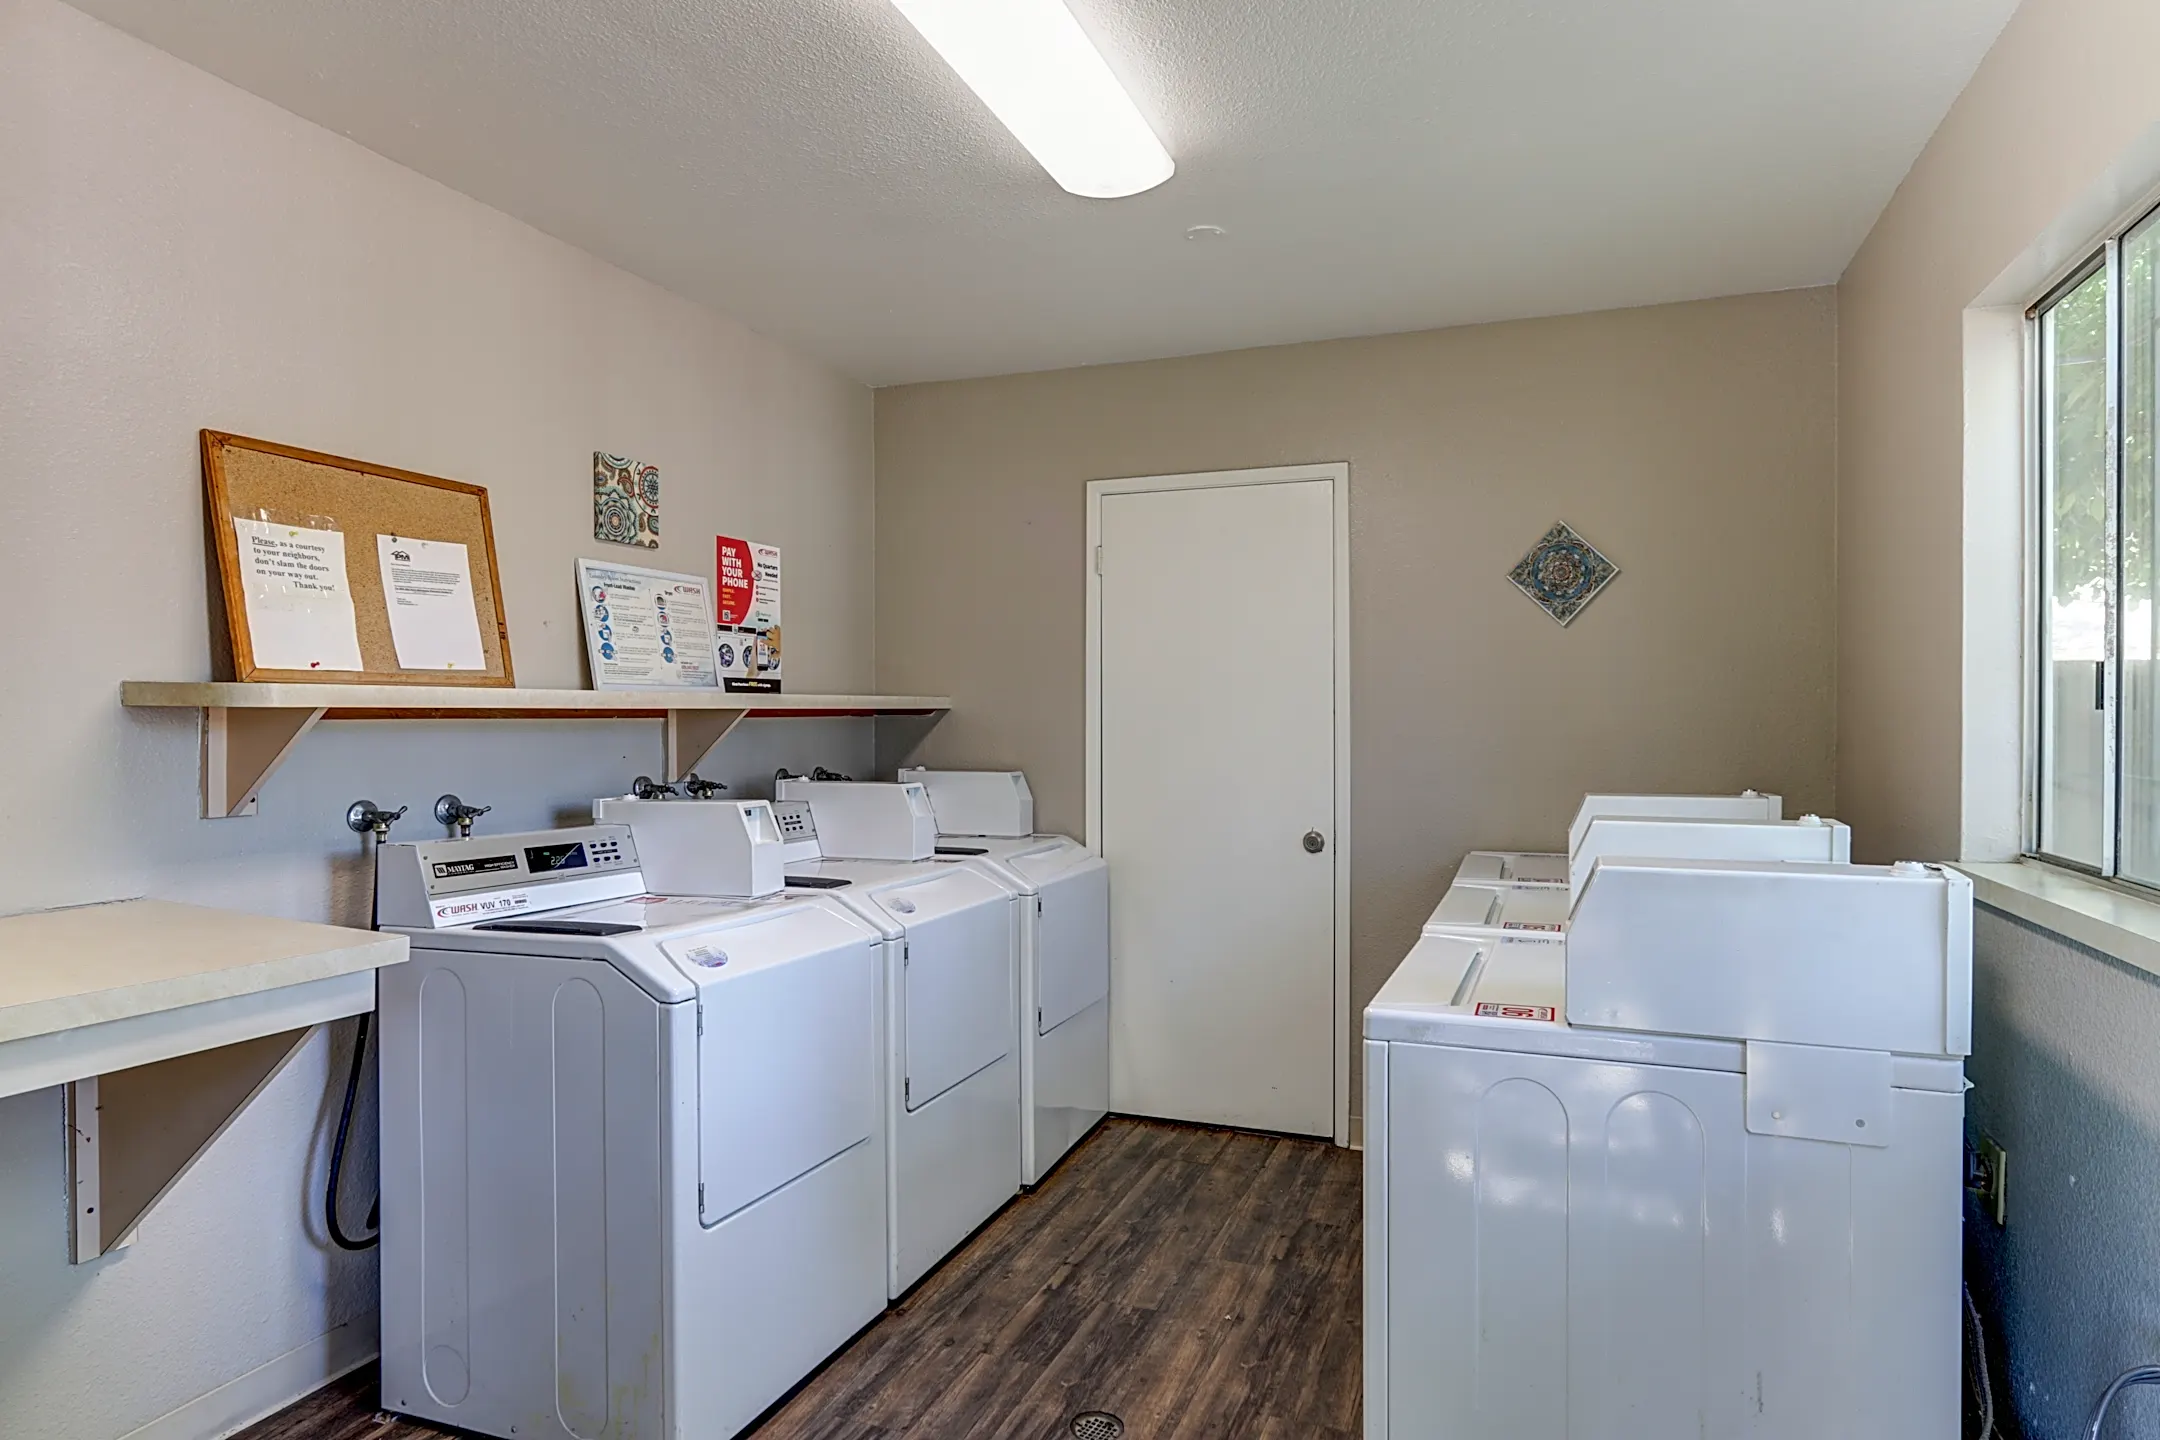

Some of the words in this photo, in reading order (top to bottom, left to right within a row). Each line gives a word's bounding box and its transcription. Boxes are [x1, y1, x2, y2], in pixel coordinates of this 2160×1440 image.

[251, 536, 278, 547] Please,
[295, 543, 325, 553] courtesy
[262, 549, 280, 557] your
[282, 550, 320, 562] neighbors,
[721, 546, 736, 557] PAY
[254, 557, 275, 566] don't
[276, 560, 295, 568] slam
[296, 562, 307, 570] the
[308, 563, 330, 572] doors
[721, 556, 742, 568] WITH
[287, 571, 302, 580] way
[304, 573, 319, 581] out.
[721, 566, 743, 578] YOUR
[292, 580, 318, 590] Thank
[319, 584, 335, 592] you!
[722, 576, 749, 589] PHONE
[682, 586, 701, 595] WASH
[447, 864, 475, 873] MAYTAG
[450, 903, 478, 915] WASH
[480, 901, 495, 910] VUV
